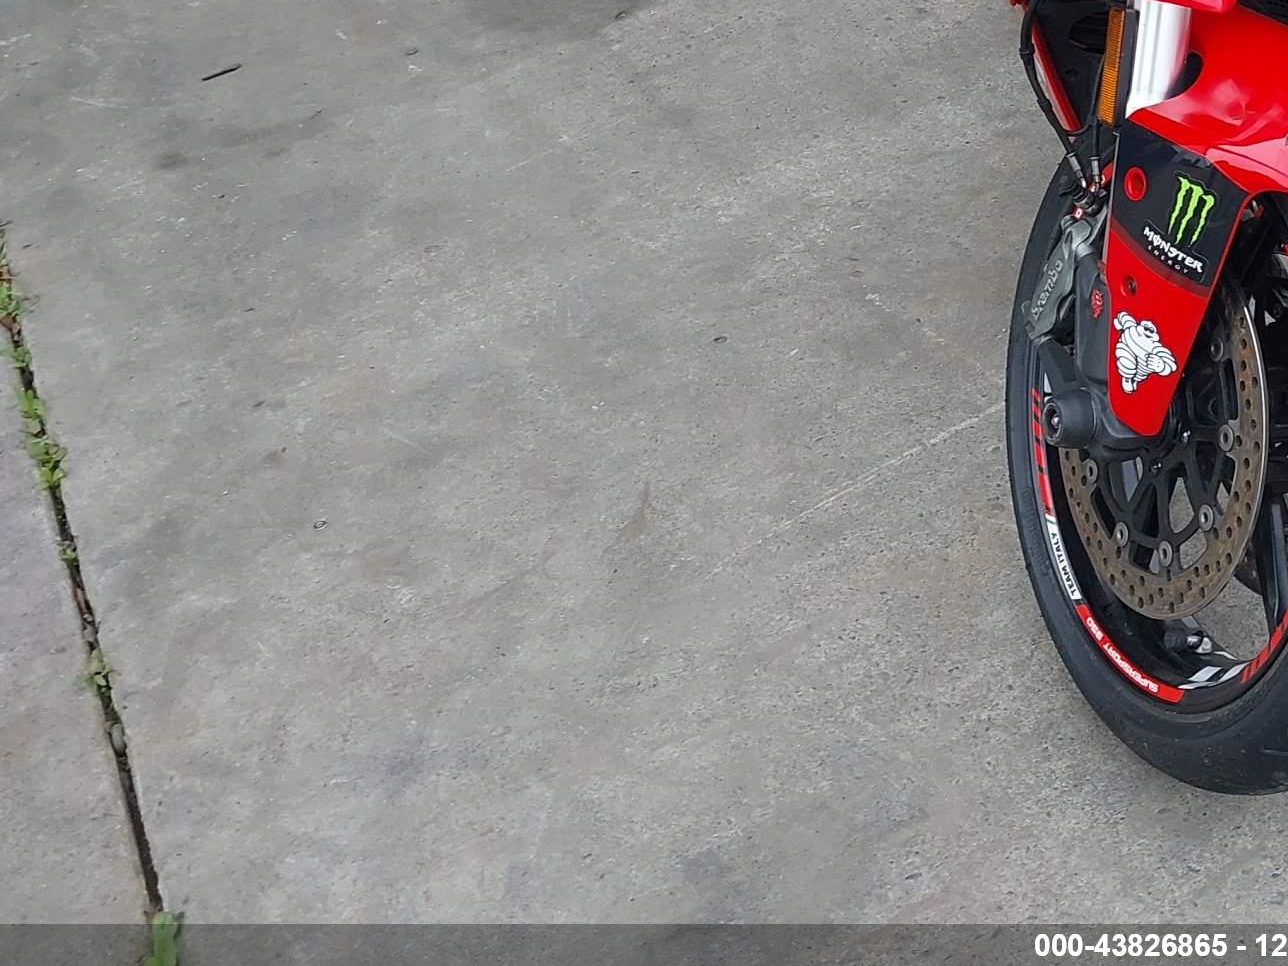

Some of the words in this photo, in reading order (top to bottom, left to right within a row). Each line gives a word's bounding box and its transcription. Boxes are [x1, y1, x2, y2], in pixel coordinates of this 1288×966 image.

[1143, 226, 1203, 273] MONSTER
[1147, 244, 1190, 274] ENERGY
[1051, 532, 1065, 564] ITALY
[1061, 565, 1076, 597] TEAM
[1086, 616, 1104, 641] 950
[1102, 642, 1159, 693] SUPERSPORT
